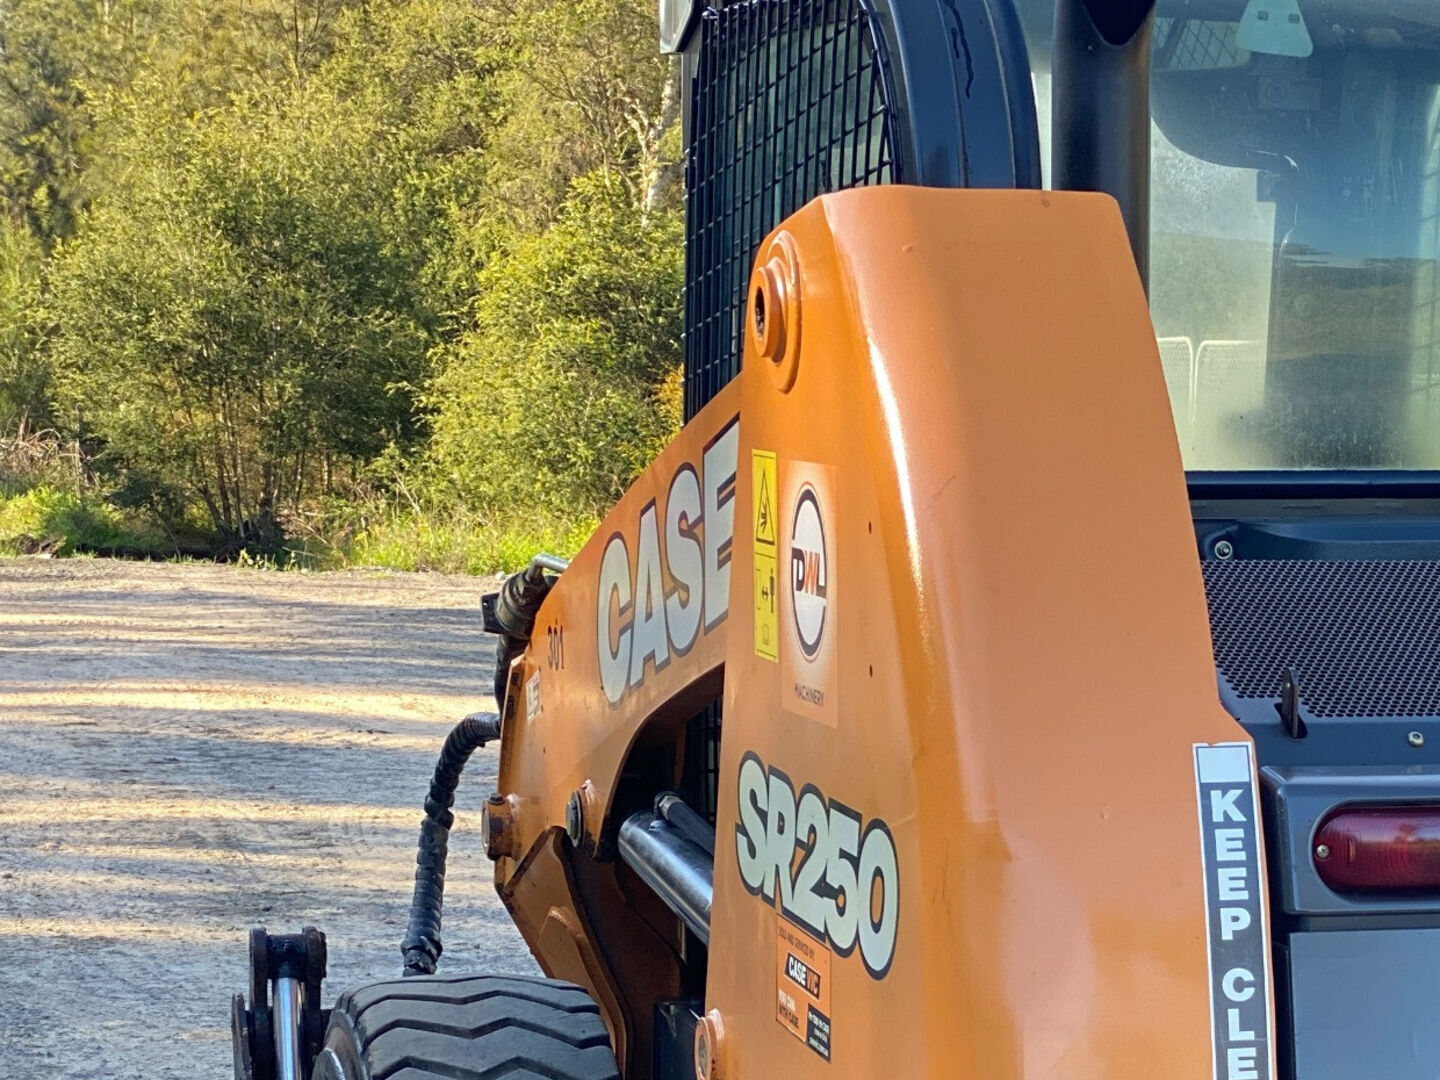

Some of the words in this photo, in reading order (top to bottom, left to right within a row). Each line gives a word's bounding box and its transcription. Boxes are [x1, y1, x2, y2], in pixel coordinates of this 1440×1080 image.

[598, 412, 741, 710] CASE
[735, 750, 900, 981] SR250
[1210, 789, 1251, 941] KEEP
